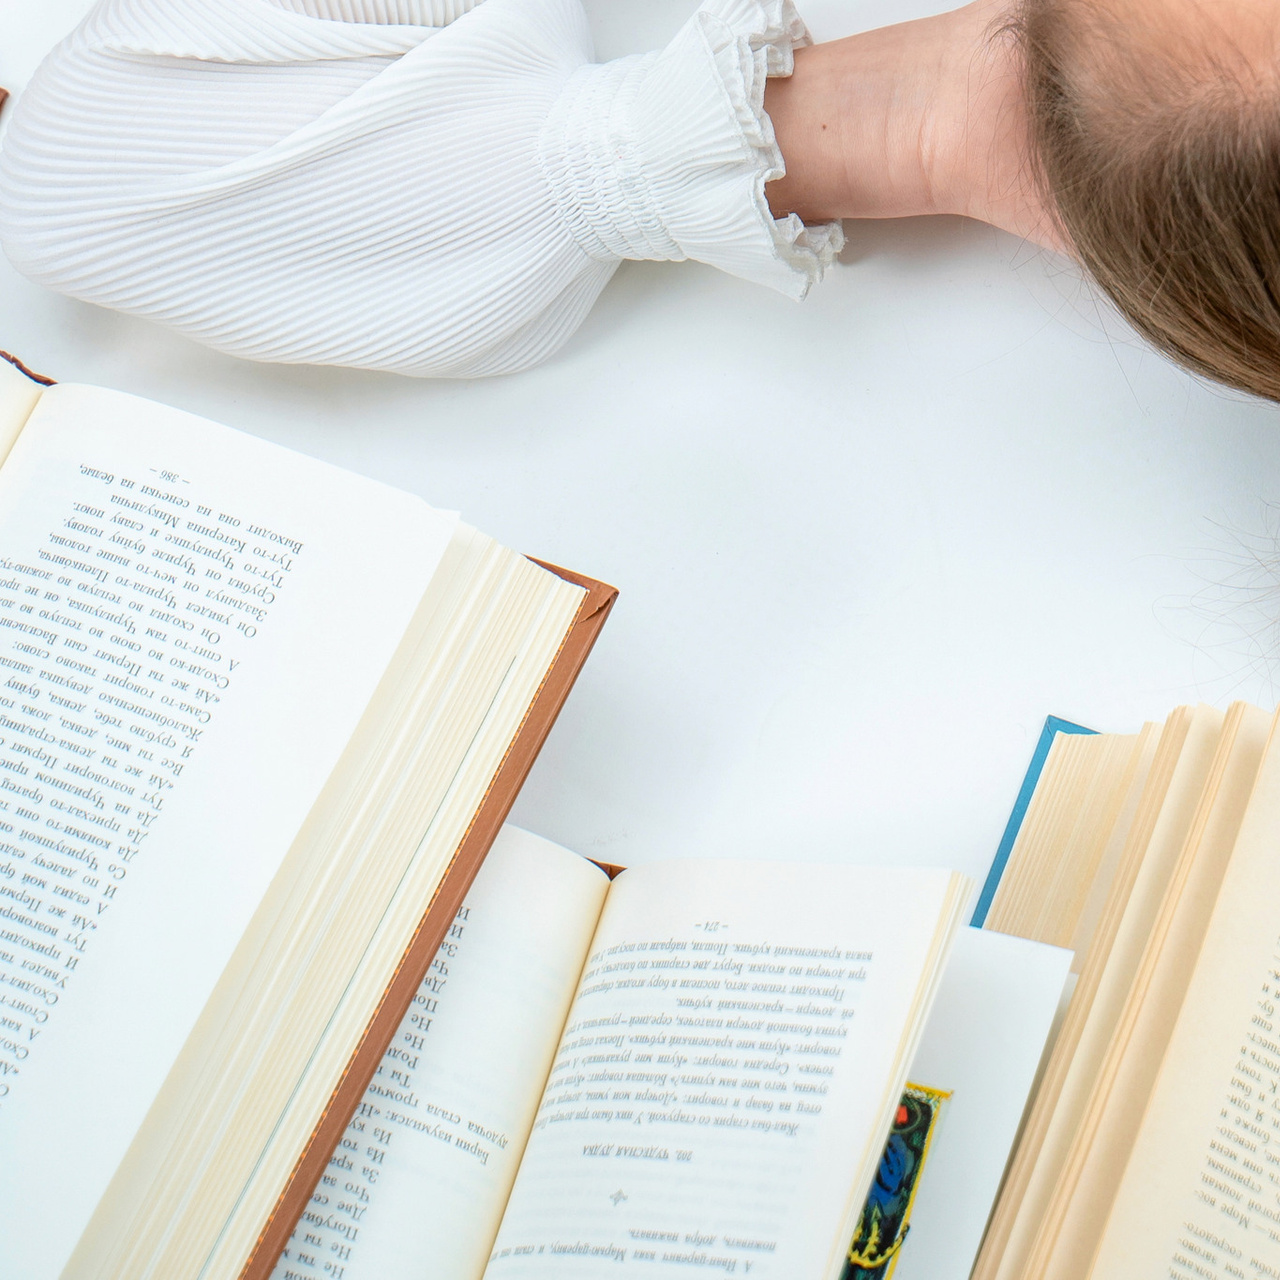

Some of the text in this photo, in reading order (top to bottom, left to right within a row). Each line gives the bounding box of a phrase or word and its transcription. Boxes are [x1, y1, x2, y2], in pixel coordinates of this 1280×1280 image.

[78, 462, 305, 556] Выходит она на сенечки на белые,
[159, 468, 179, 483] 386
[62, 515, 277, 606] Срубил он Чуриле буйну голову.
[72, 501, 285, 590] Тут-то Чурилушке и славу поют.
[109, 493, 294, 573] Тут-то Катерина Микулична
[48, 531, 269, 623] Заздынул он меч-то выше головы,
[114, 575, 258, 639] Он увидел Чурила-то
[368, 1082, 510, 1151] дудочка стала громче
[385, 1109, 491, 1167] Барин изумился:
[581, 1142, 616, 1158] ДУДКА
[613, 1144, 671, 1162] ЧУДЕСНАЯ
